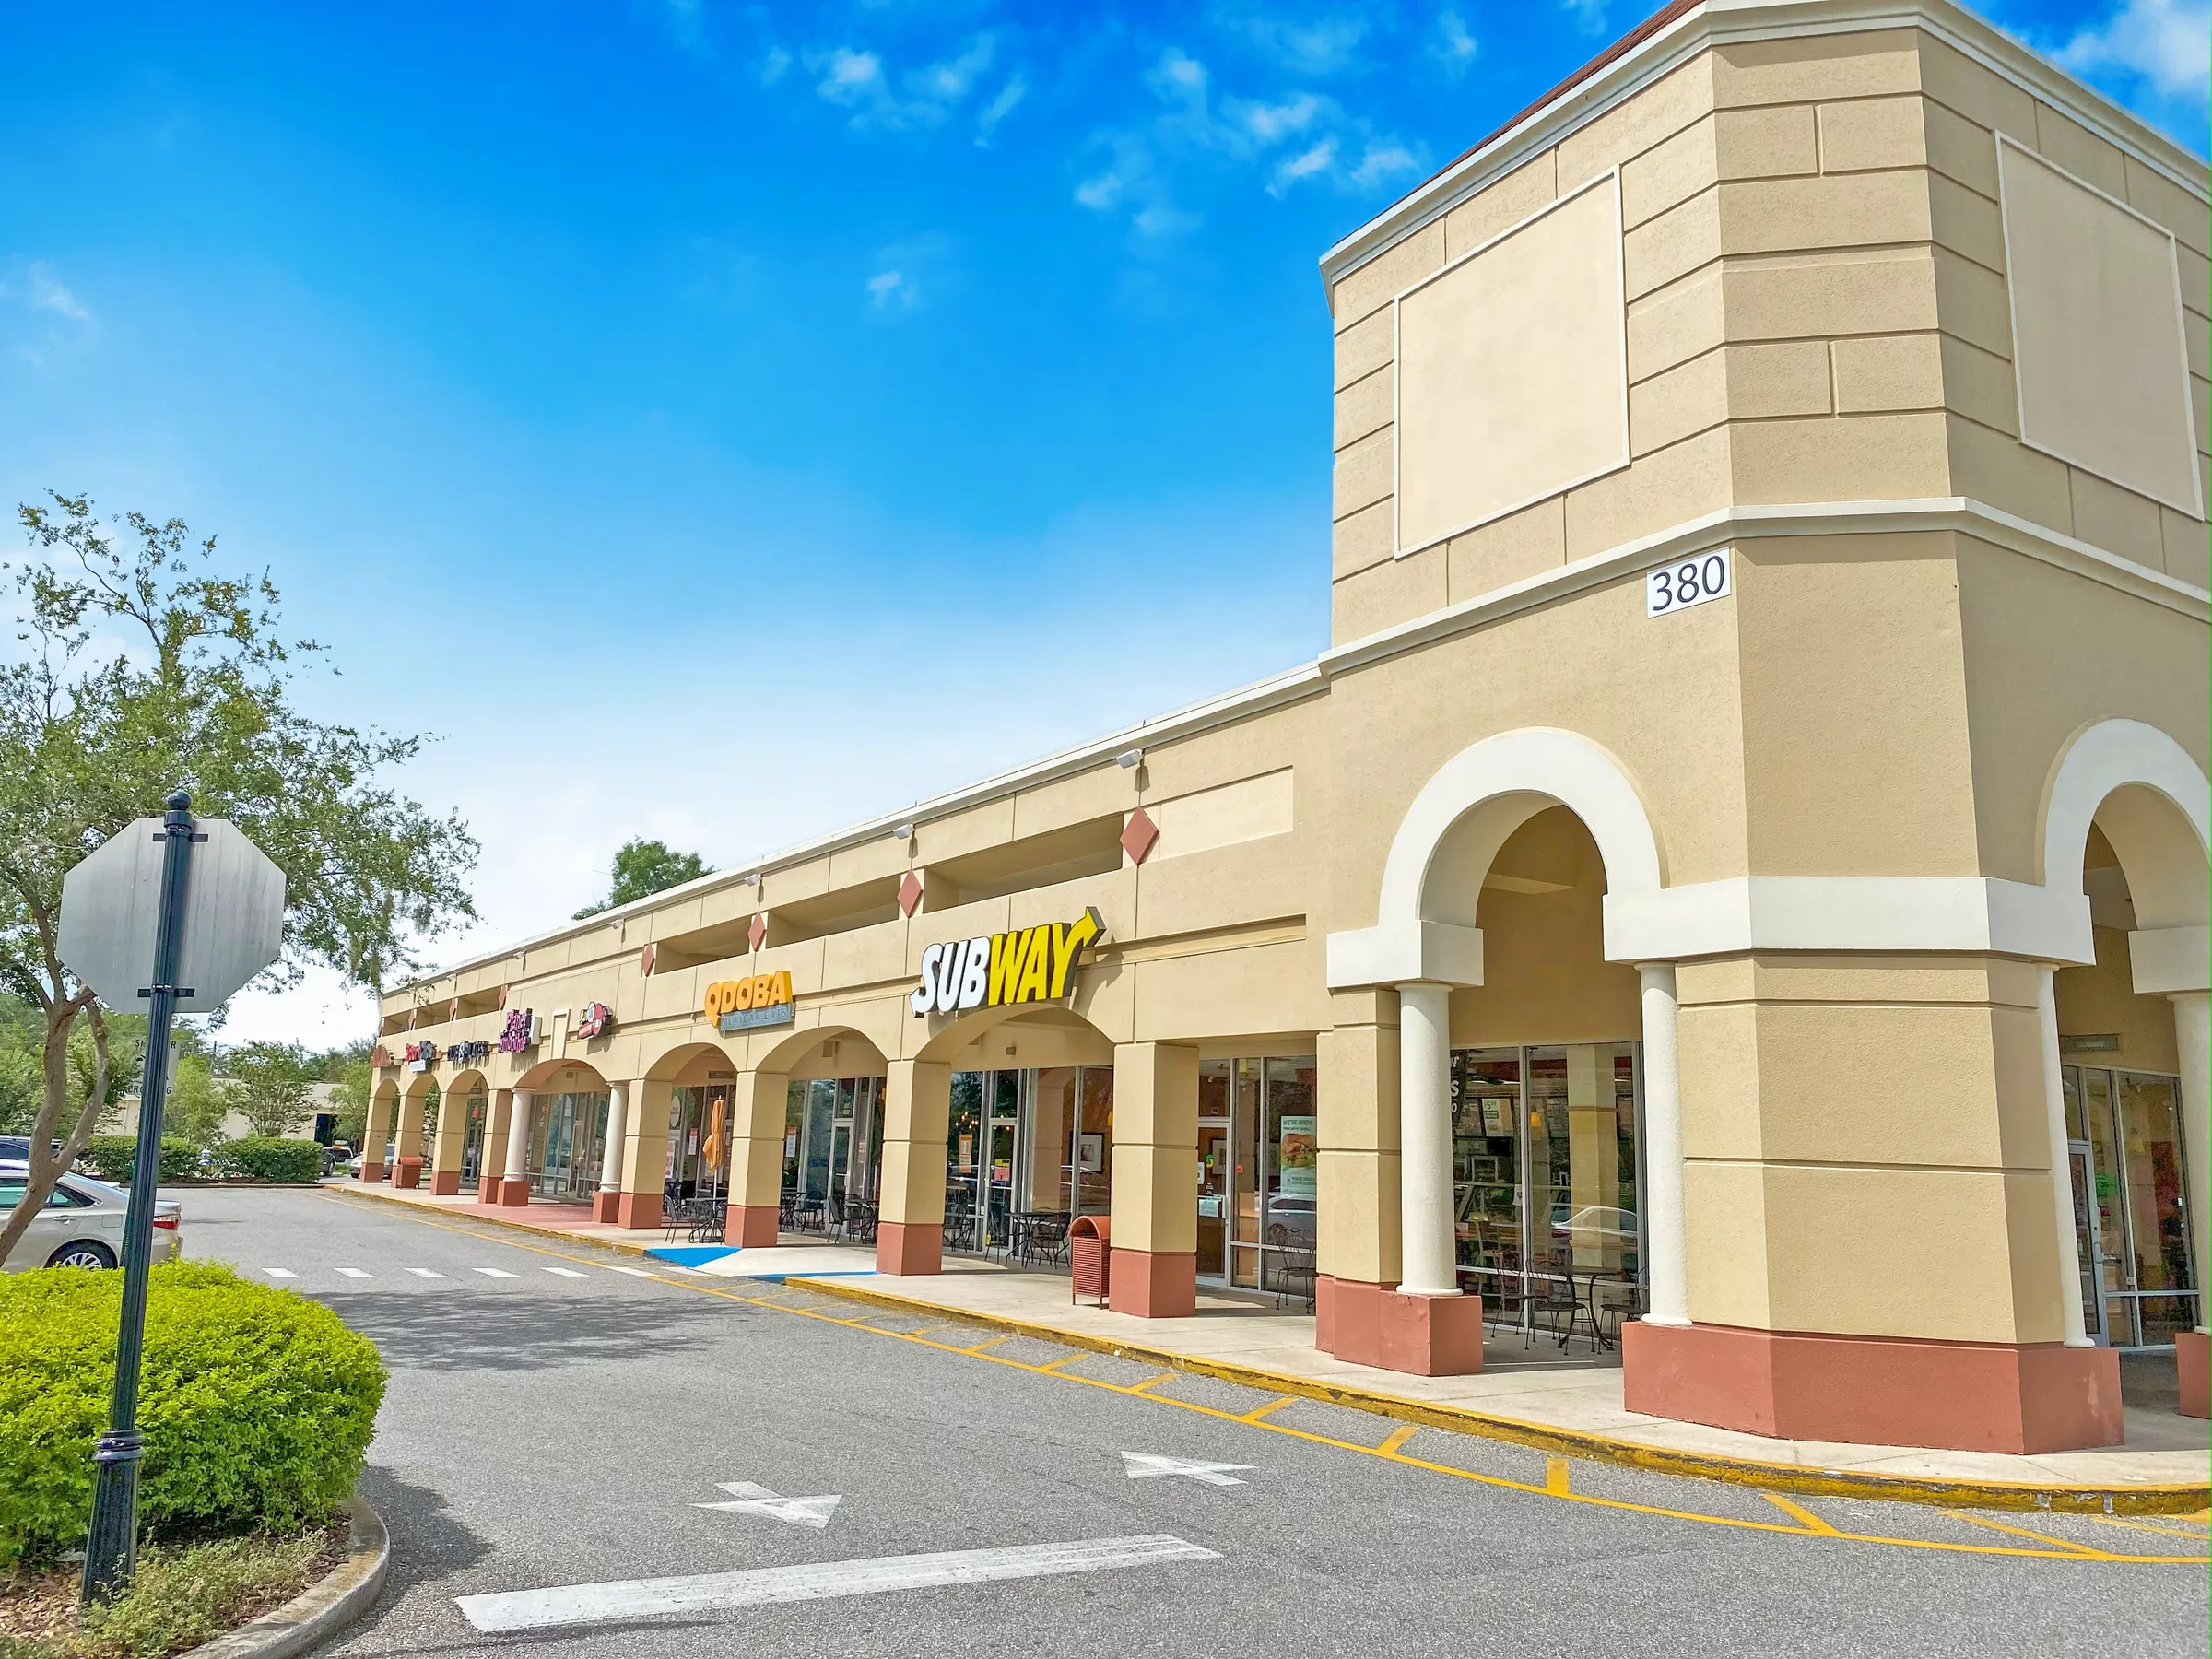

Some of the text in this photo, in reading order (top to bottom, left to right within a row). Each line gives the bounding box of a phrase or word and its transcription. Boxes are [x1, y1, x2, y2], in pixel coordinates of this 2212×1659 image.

[1653, 555, 1725, 612] 380
[909, 907, 1107, 1018] SUBWAY
[704, 971, 793, 1029] QDOBA
[722, 1007, 788, 1026] MEXICAN EATS
